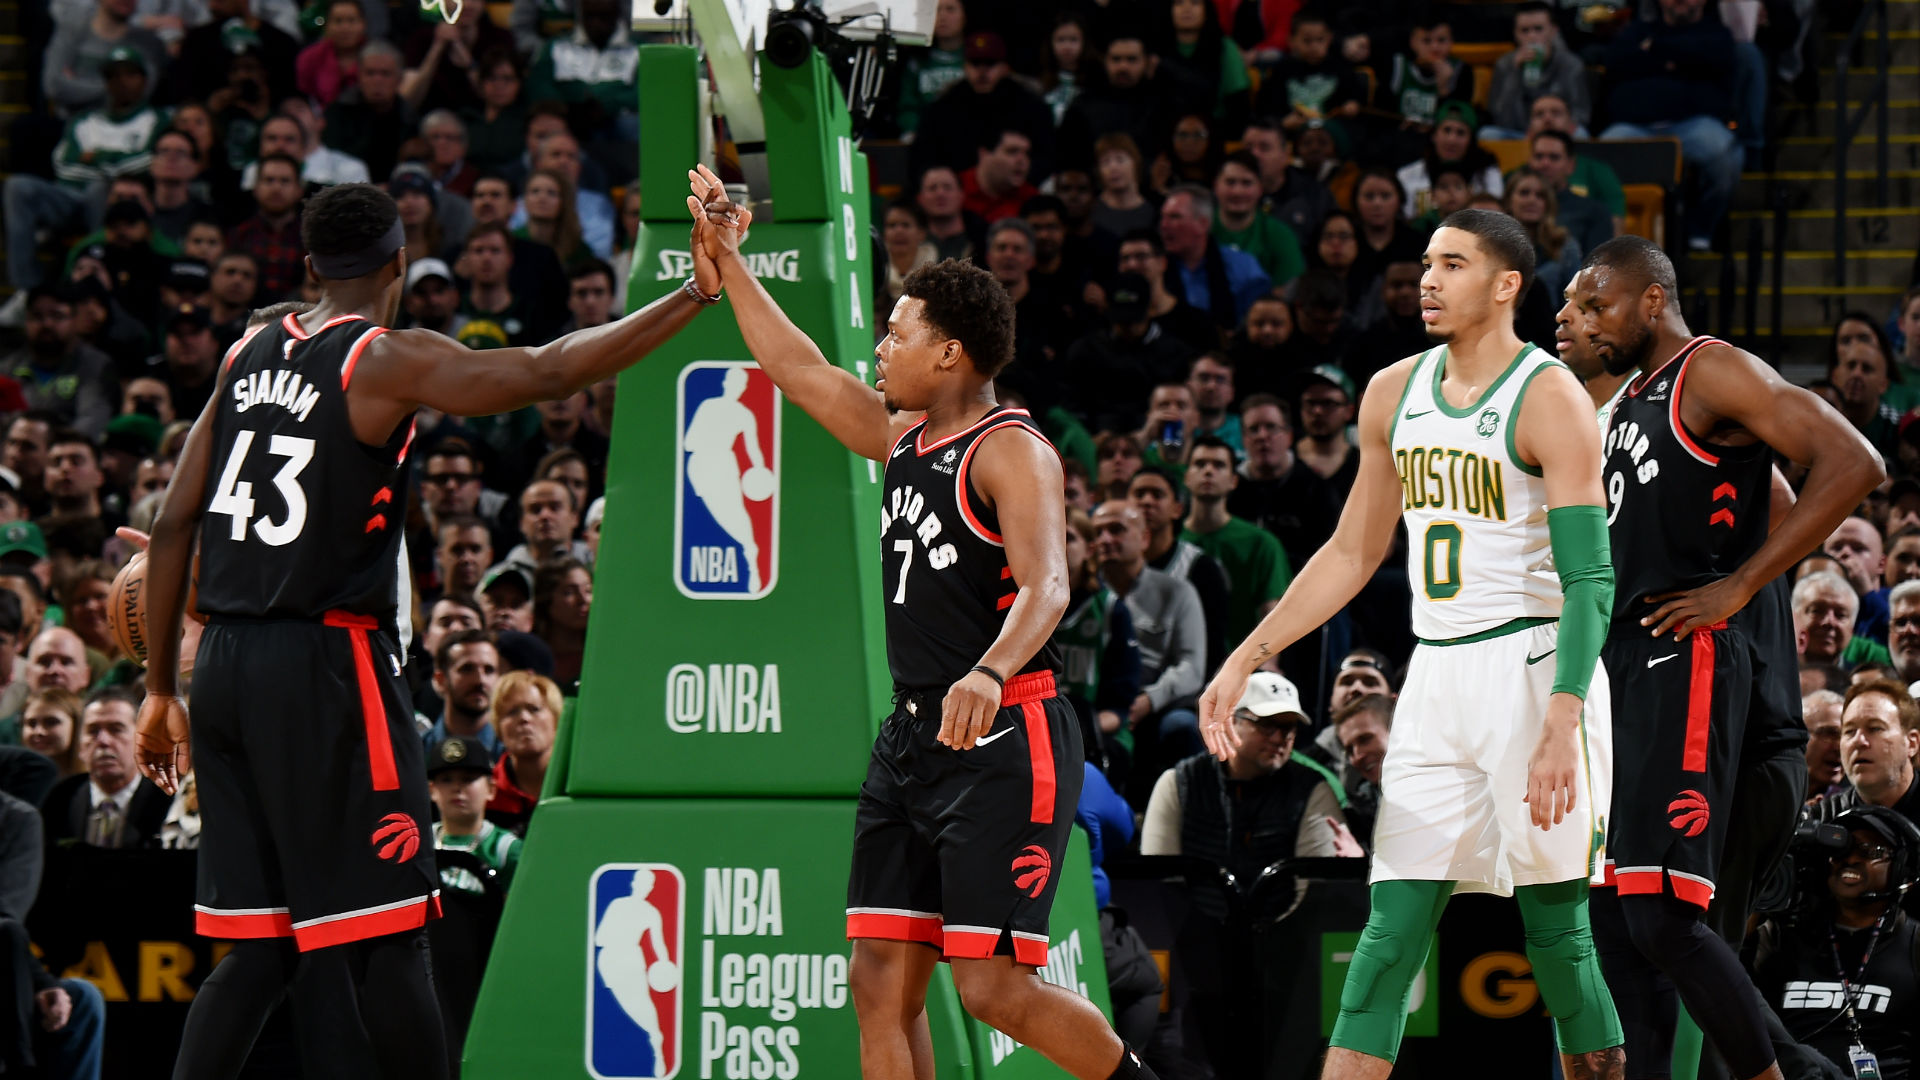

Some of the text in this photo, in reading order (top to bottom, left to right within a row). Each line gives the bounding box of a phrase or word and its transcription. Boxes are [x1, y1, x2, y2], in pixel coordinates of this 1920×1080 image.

[656, 249, 800, 281] SPING
[838, 136, 865, 330] NBA
[1858, 218, 1889, 243] 12
[233, 370, 321, 423] SIAKAM
[208, 429, 316, 547] 43
[1396, 446, 1507, 522] BOSTON
[881, 485, 958, 571] APTORS
[1423, 521, 1464, 602] 0
[690, 546, 738, 583] NBA
[892, 540, 914, 605] 7
[125, 578, 148, 660] SPALDIN
[665, 664, 782, 734] @NBA
[703, 867, 784, 937] NBA
[700, 939, 848, 1022] League
[1782, 980, 1892, 1014] ESPN
[699, 1012, 801, 1080] Pass
